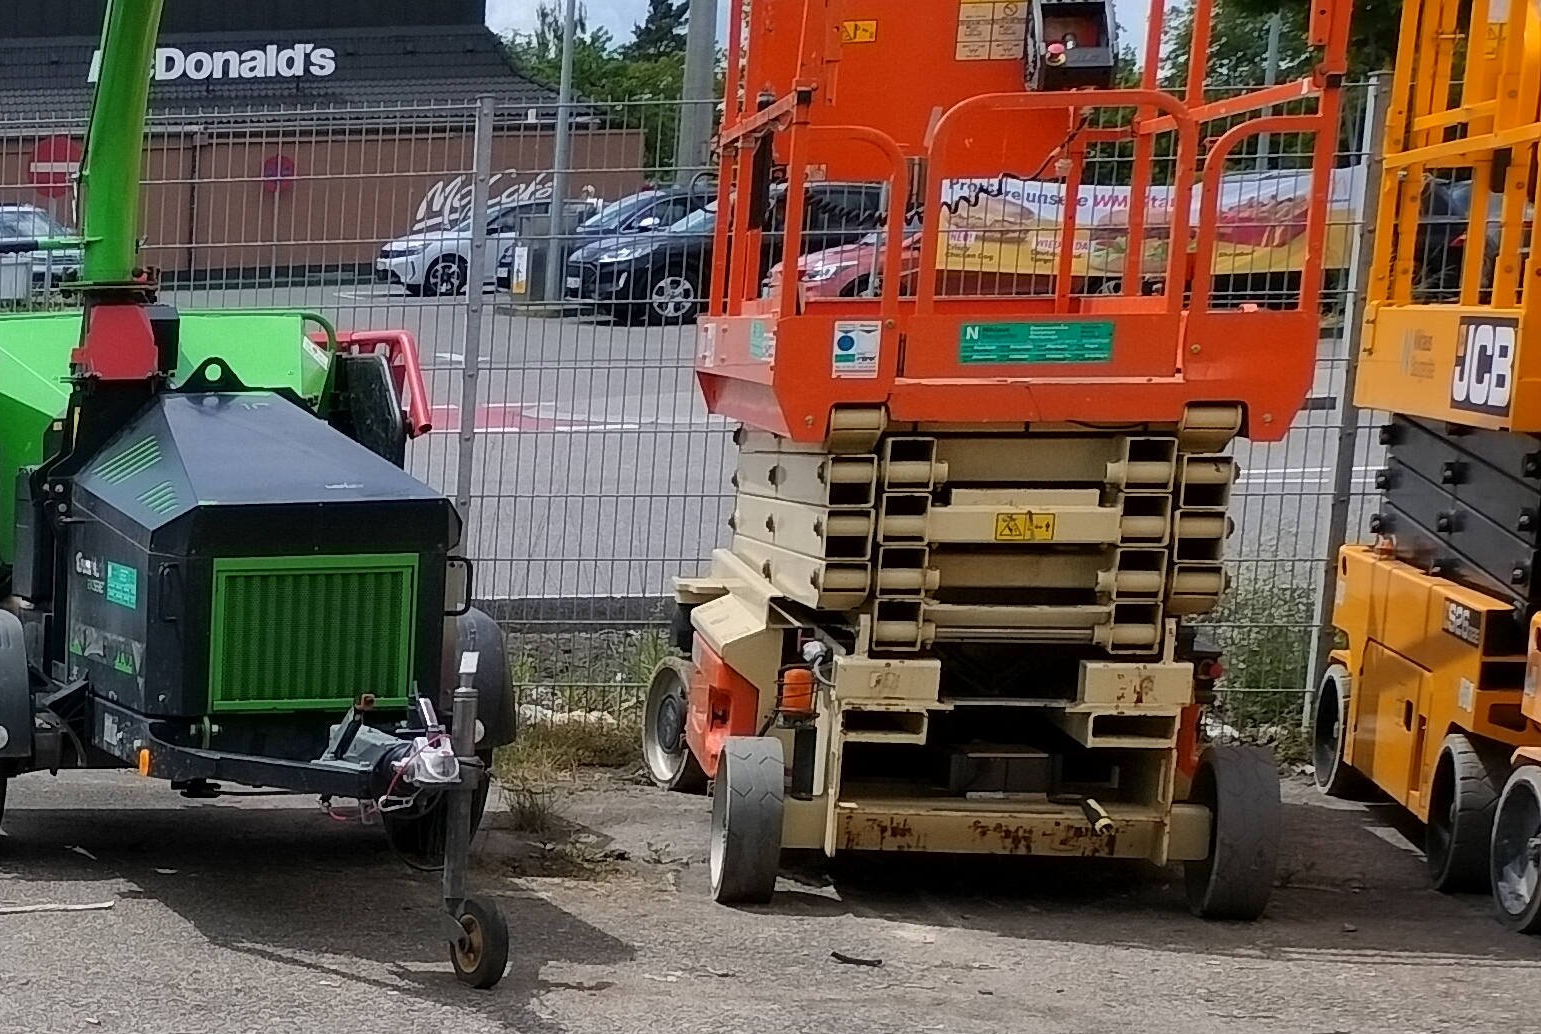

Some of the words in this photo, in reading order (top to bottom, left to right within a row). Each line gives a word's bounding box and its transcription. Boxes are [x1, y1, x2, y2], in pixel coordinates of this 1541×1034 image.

[87, 43, 336, 83] Donald's
[965, 326, 979, 340] N
[1453, 324, 1516, 408] JCB
